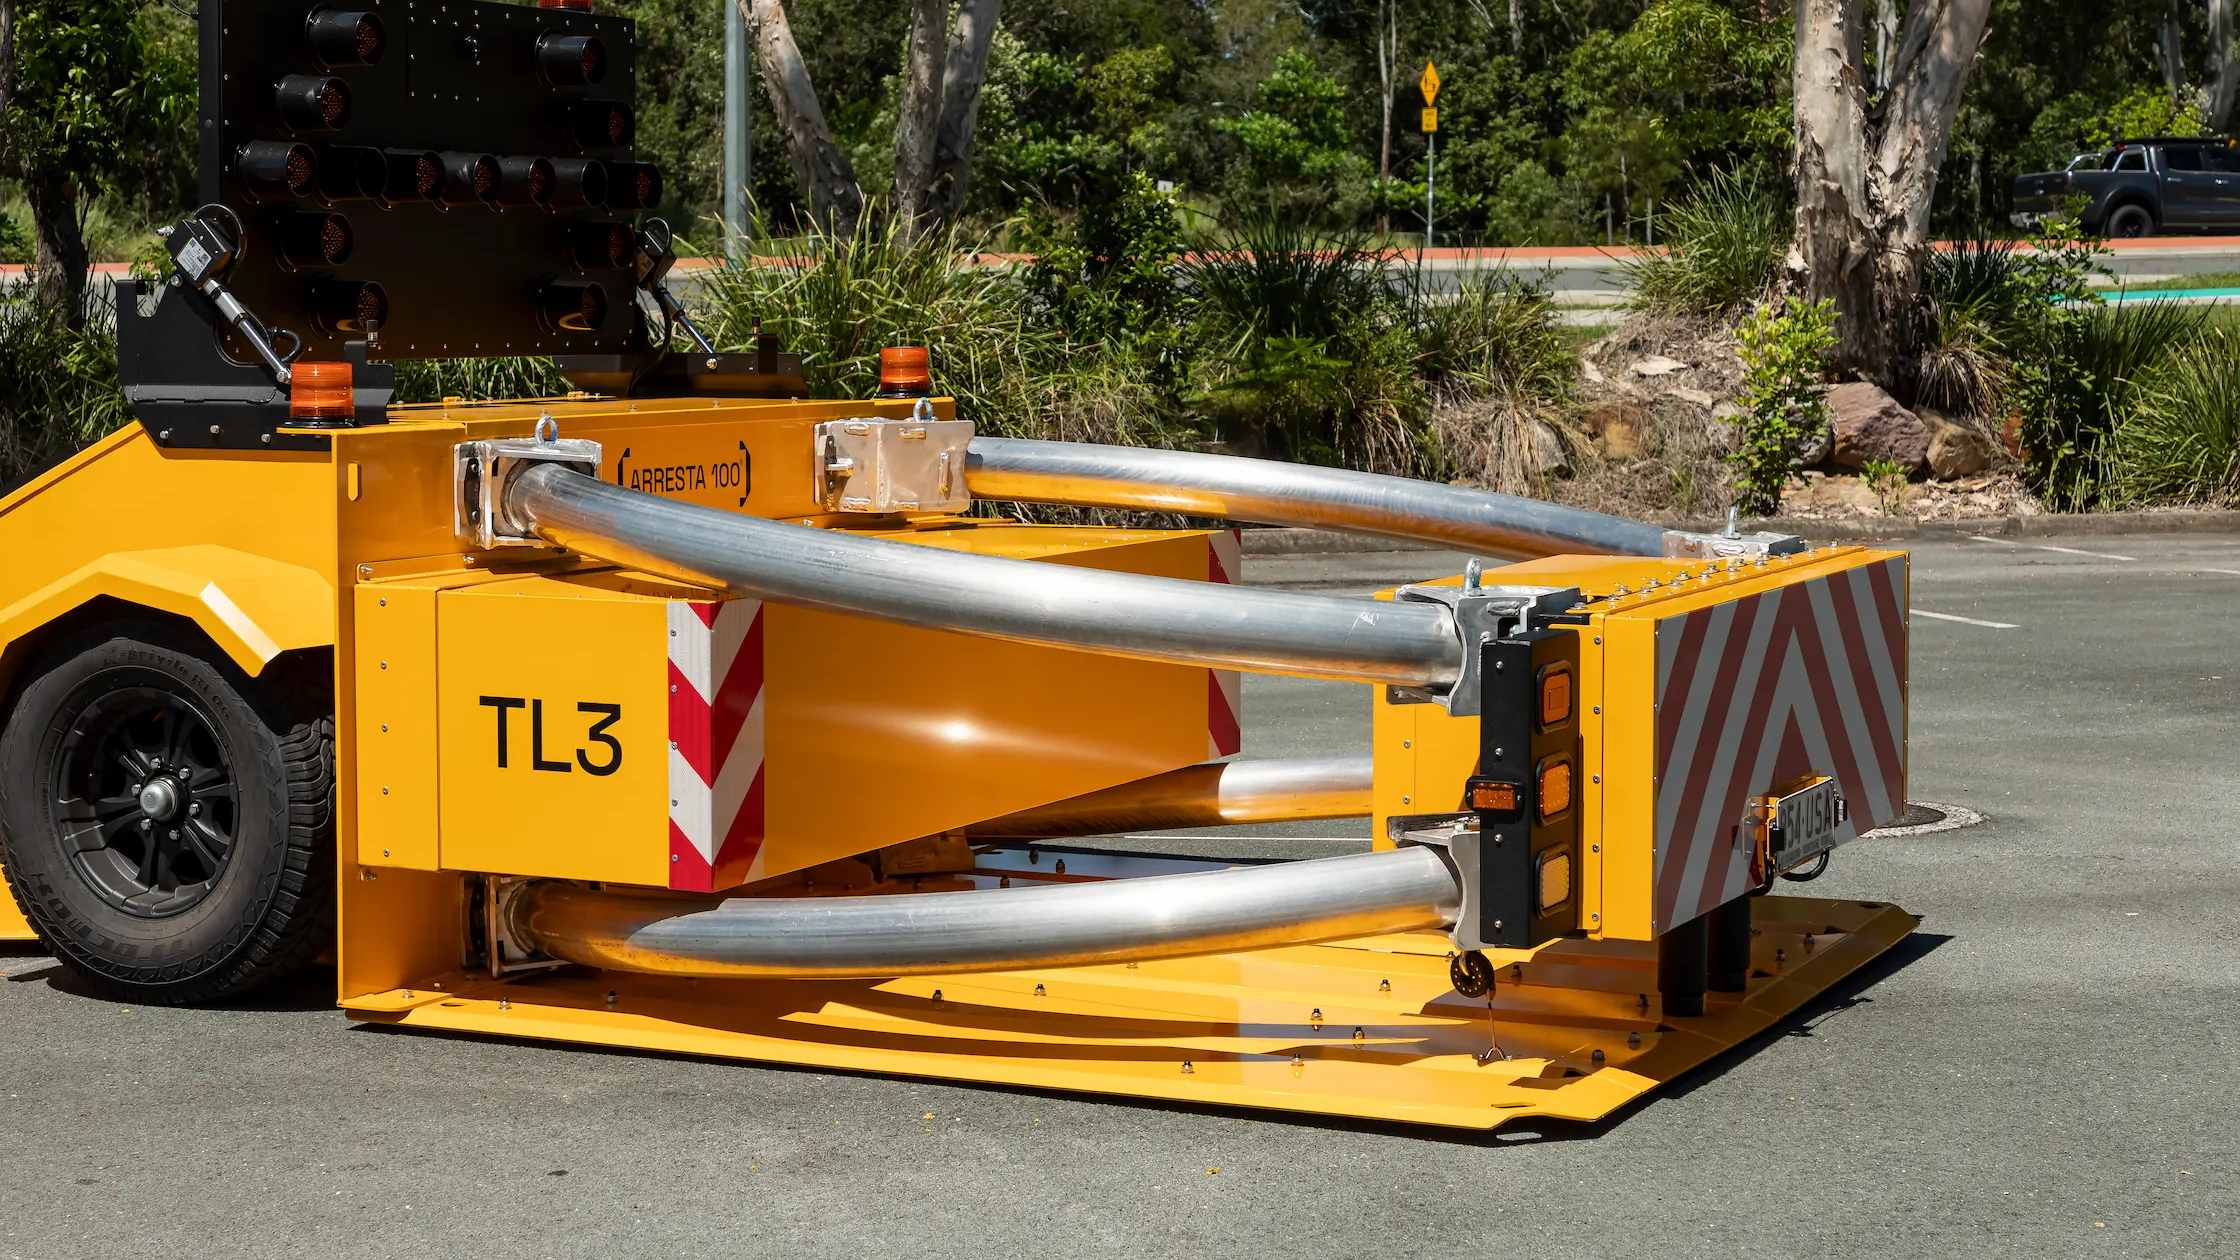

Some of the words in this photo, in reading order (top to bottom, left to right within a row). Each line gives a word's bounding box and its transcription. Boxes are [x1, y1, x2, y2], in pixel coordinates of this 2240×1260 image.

[631, 465, 706, 494] ARRESTA
[711, 462, 741, 488] 100
[479, 695, 623, 777] TL3
